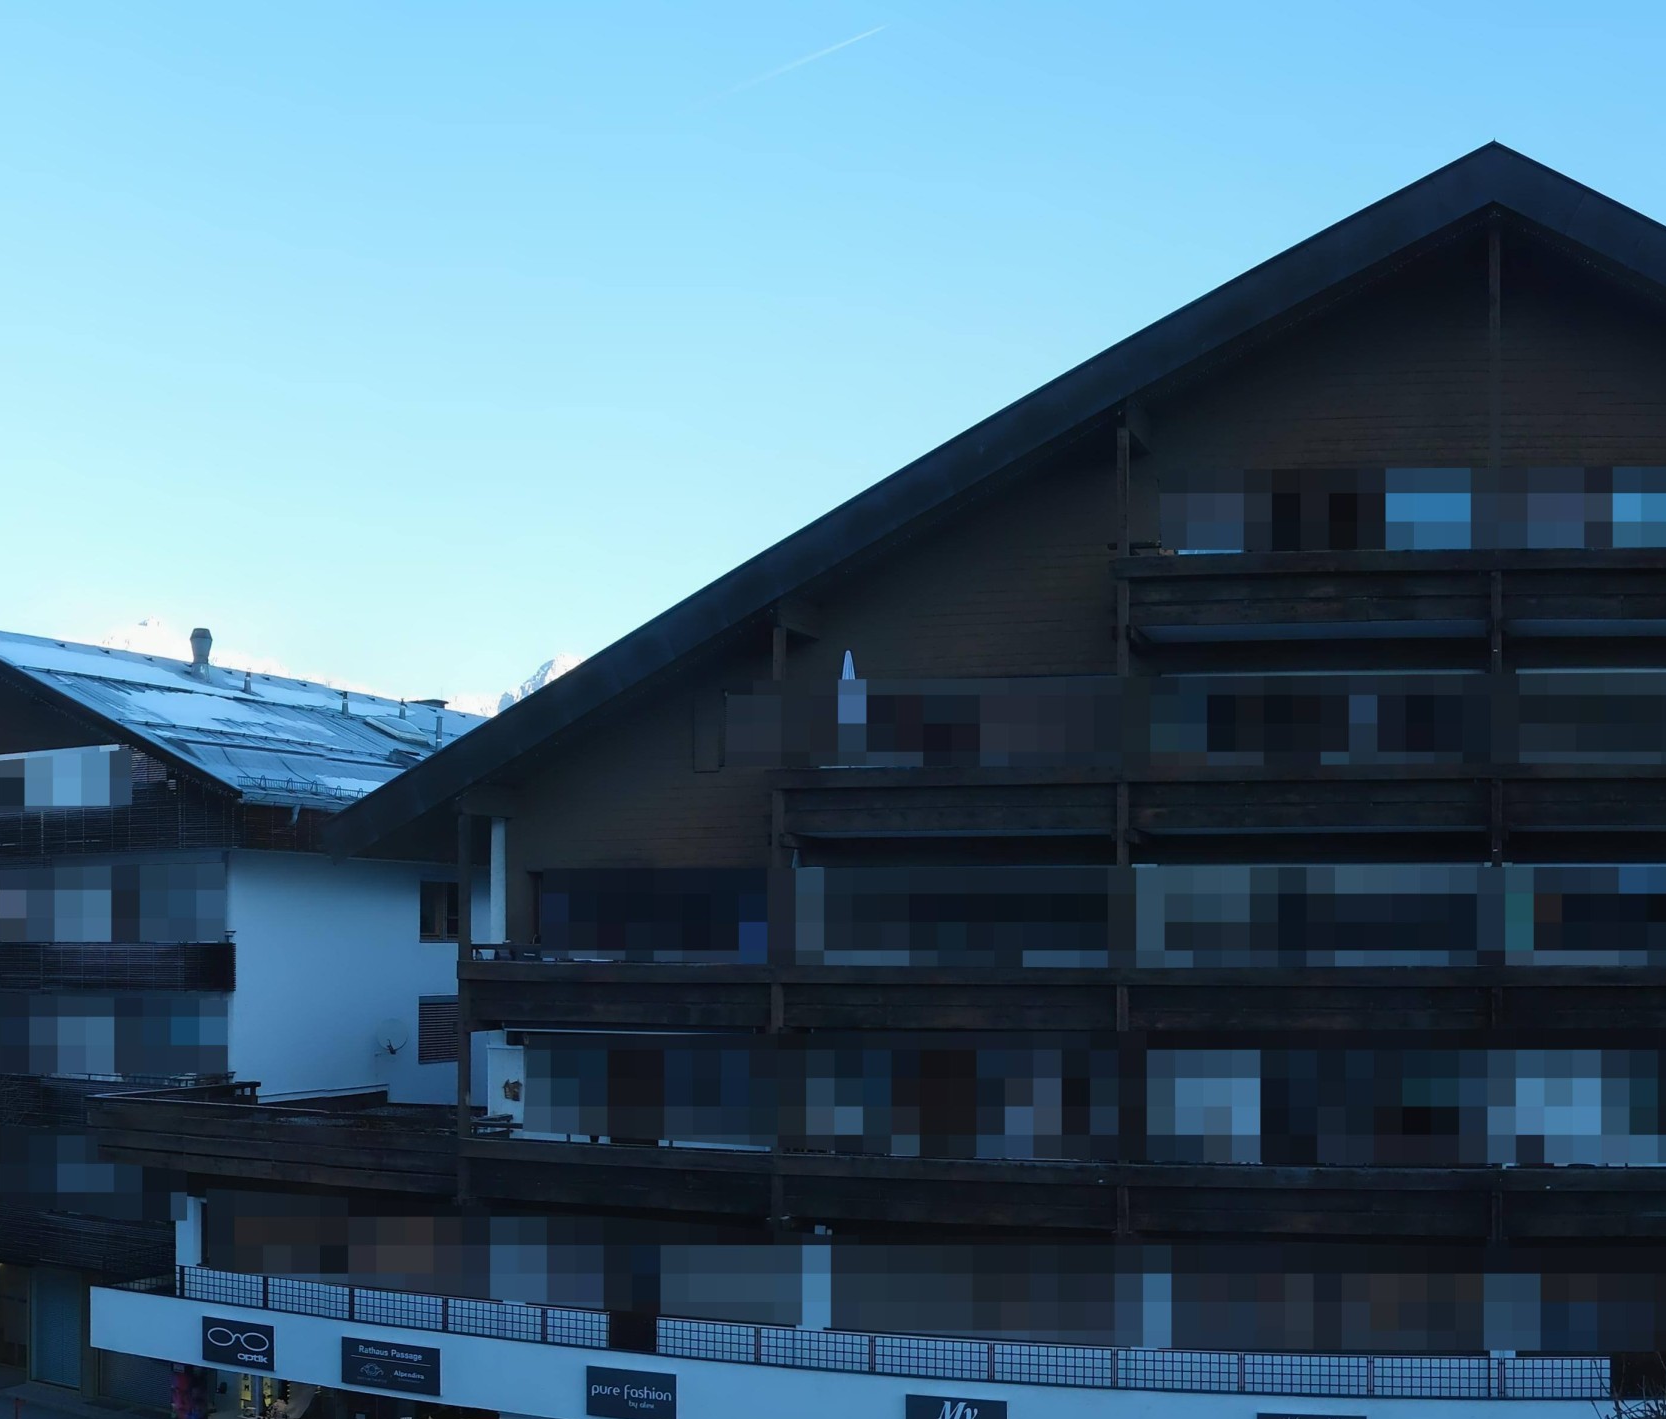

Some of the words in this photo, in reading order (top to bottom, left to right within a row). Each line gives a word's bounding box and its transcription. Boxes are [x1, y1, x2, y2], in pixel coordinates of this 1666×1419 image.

[237, 1353, 269, 1365] optik
[358, 1345, 388, 1358] Rathaus
[391, 1349, 423, 1362] Passage
[591, 1384, 621, 1397] pure
[624, 1384, 672, 1402] fashion
[628, 1400, 639, 1410] by
